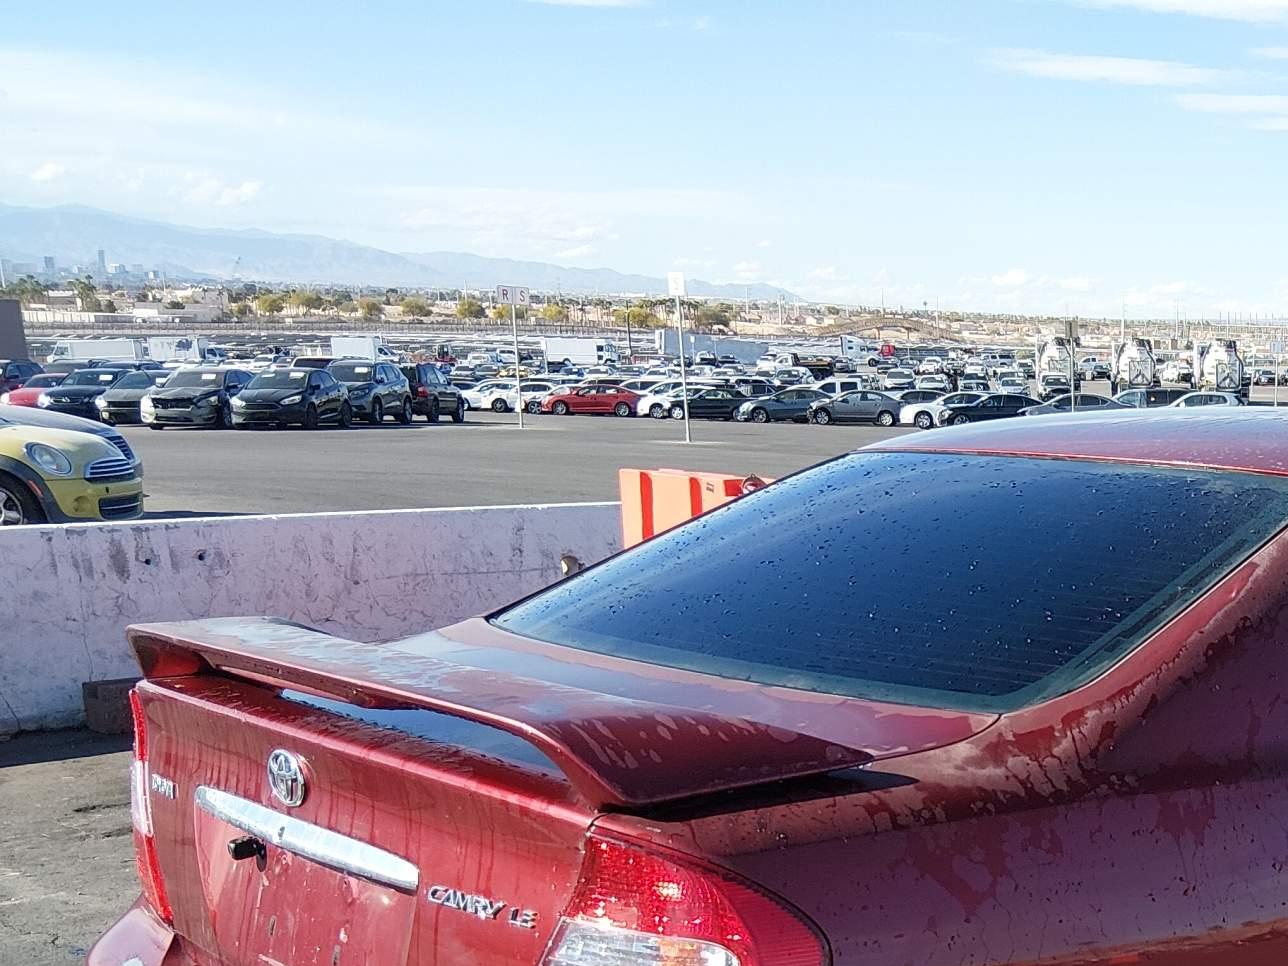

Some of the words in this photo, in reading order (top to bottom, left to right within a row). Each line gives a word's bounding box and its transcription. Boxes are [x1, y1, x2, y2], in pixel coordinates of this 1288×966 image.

[502, 288, 509, 301] R
[519, 290, 526, 302] S
[428, 885, 507, 920] CAMRY
[509, 907, 538, 929] LE
